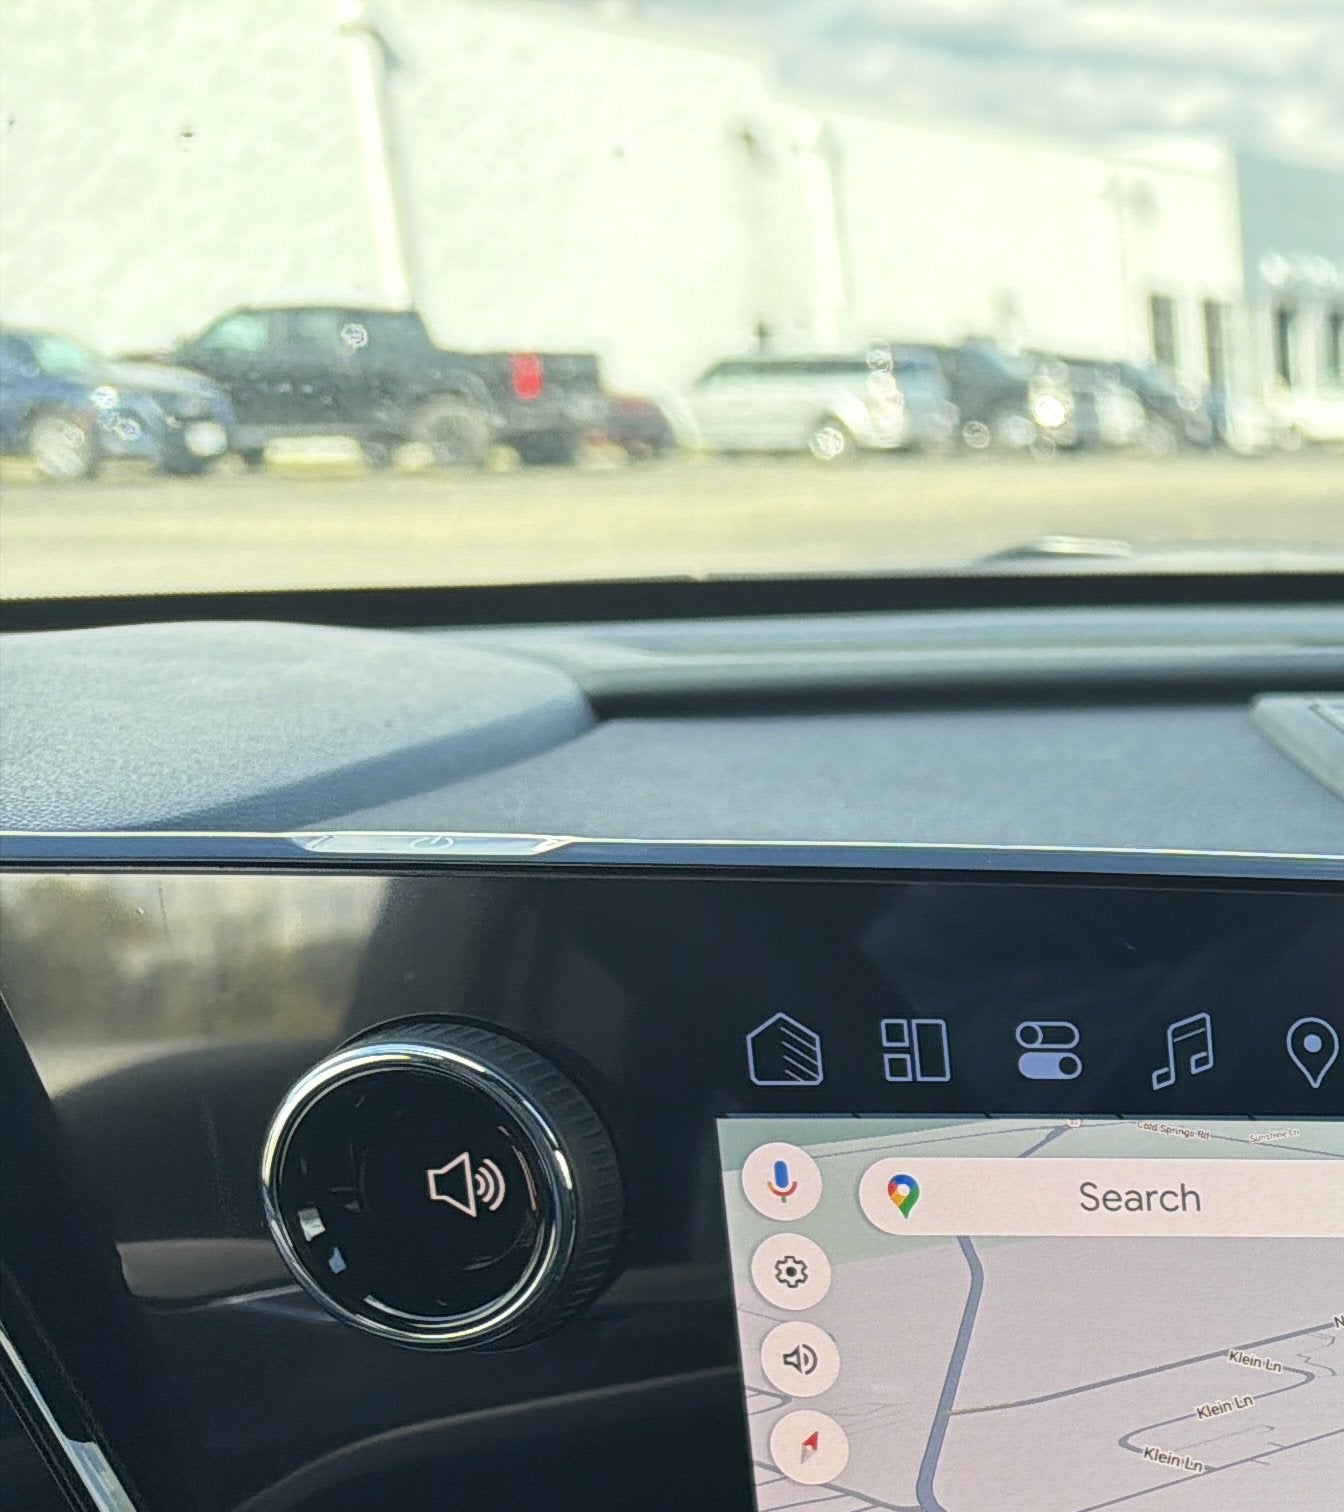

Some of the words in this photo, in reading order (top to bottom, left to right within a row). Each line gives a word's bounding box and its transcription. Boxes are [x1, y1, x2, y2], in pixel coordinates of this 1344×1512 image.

[1194, 1130, 1209, 1140] Rd
[1080, 1182, 1202, 1213] Search
[1229, 1351, 1263, 1368] Klein
[1265, 1360, 1282, 1373] Ln
[1197, 1400, 1233, 1420] Klein
[1234, 1395, 1254, 1408] Ln
[1144, 1446, 1182, 1467] Klein
[1185, 1458, 1203, 1473] Ln
